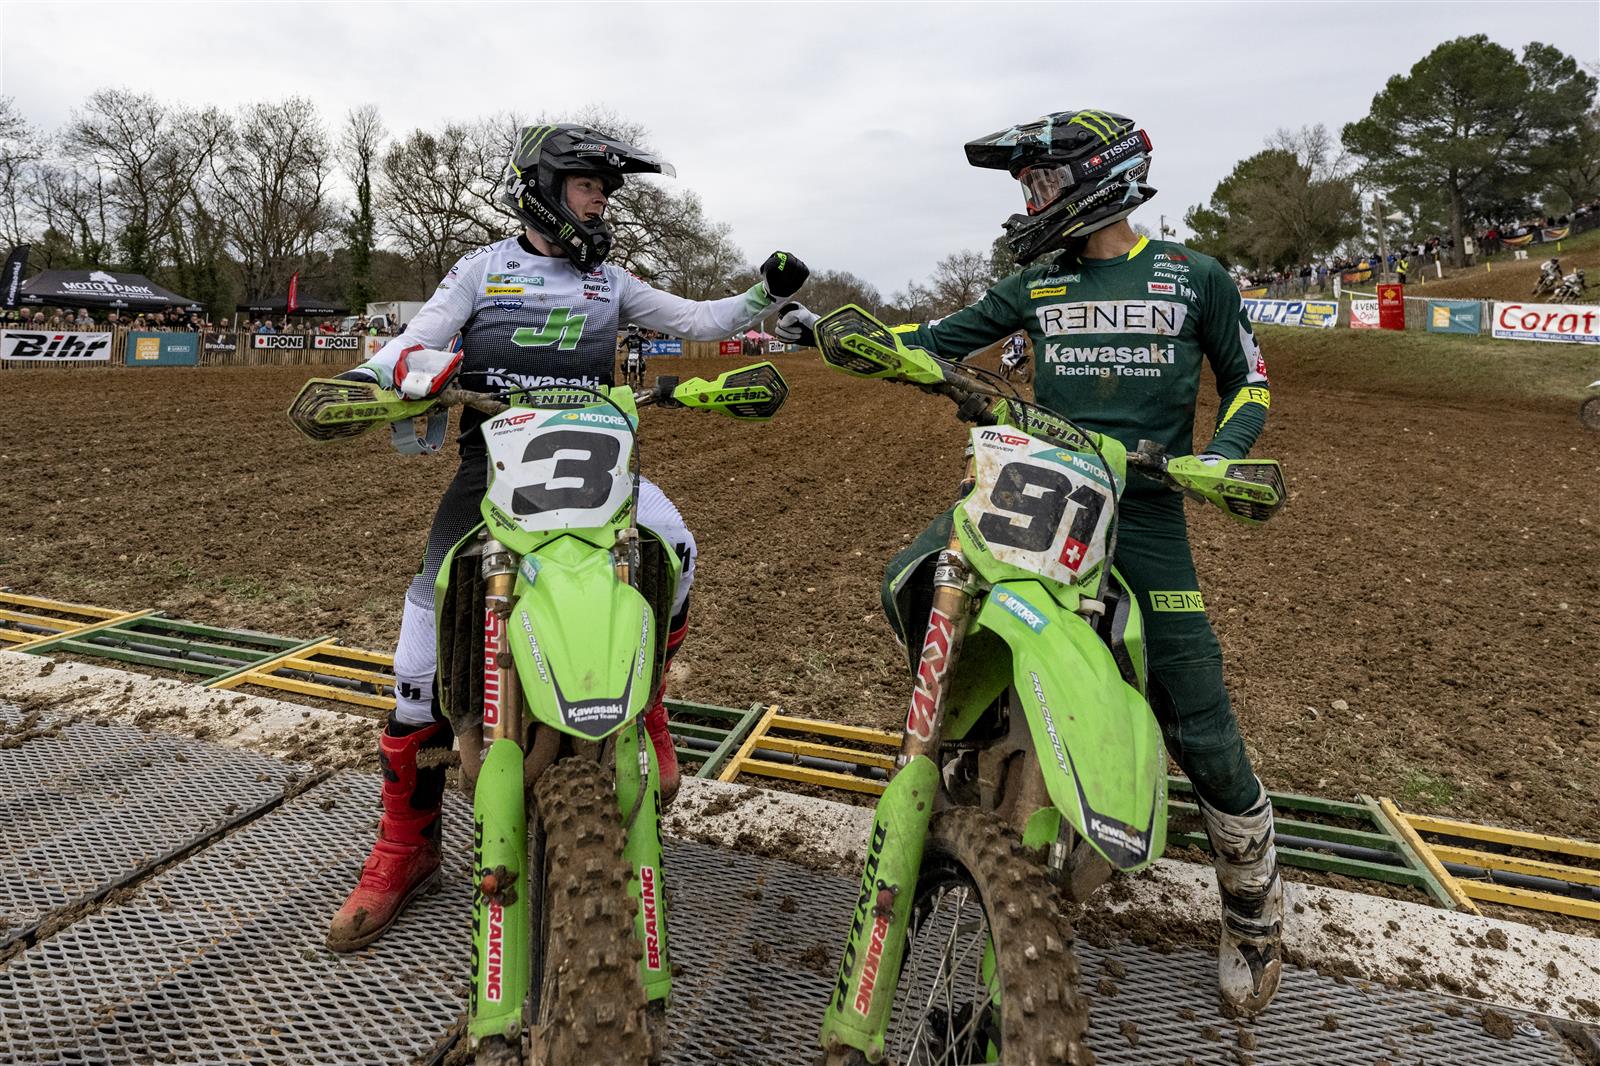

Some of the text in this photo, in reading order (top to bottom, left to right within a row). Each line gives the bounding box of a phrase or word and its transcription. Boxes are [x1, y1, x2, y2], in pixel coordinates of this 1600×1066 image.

[1100, 135, 1140, 160] TISSOT
[62, 282, 153, 294] MOTO PARK
[1500, 305, 1596, 334] Corat
[5, 333, 108, 357] Bihr
[266, 337, 304, 348] IPONE
[325, 337, 358, 348] IPONE
[1045, 343, 1175, 364] Kawasaki
[486, 367, 600, 387] Kawasaki
[1055, 365, 1161, 378] Racing Team
[714, 391, 771, 402] ACERBIS
[490, 413, 537, 431] MXGP
[580, 412, 633, 426] MOTORE
[980, 430, 1030, 446] MXGP
[511, 430, 621, 515] 3
[977, 461, 1107, 553] 91
[1004, 595, 1045, 629] MOTOREX
[528, 634, 550, 684] CIRCUIT
[568, 703, 623, 718] Kawasaki
[574, 714, 598, 723] Racing
[1030, 671, 1069, 776] PRO CIRCUIT
[641, 867, 660, 970] BRAKING
[836, 820, 888, 1014] DUNLOP
[487, 901, 504, 1001] RAKING
[854, 917, 889, 1018] RAKING
